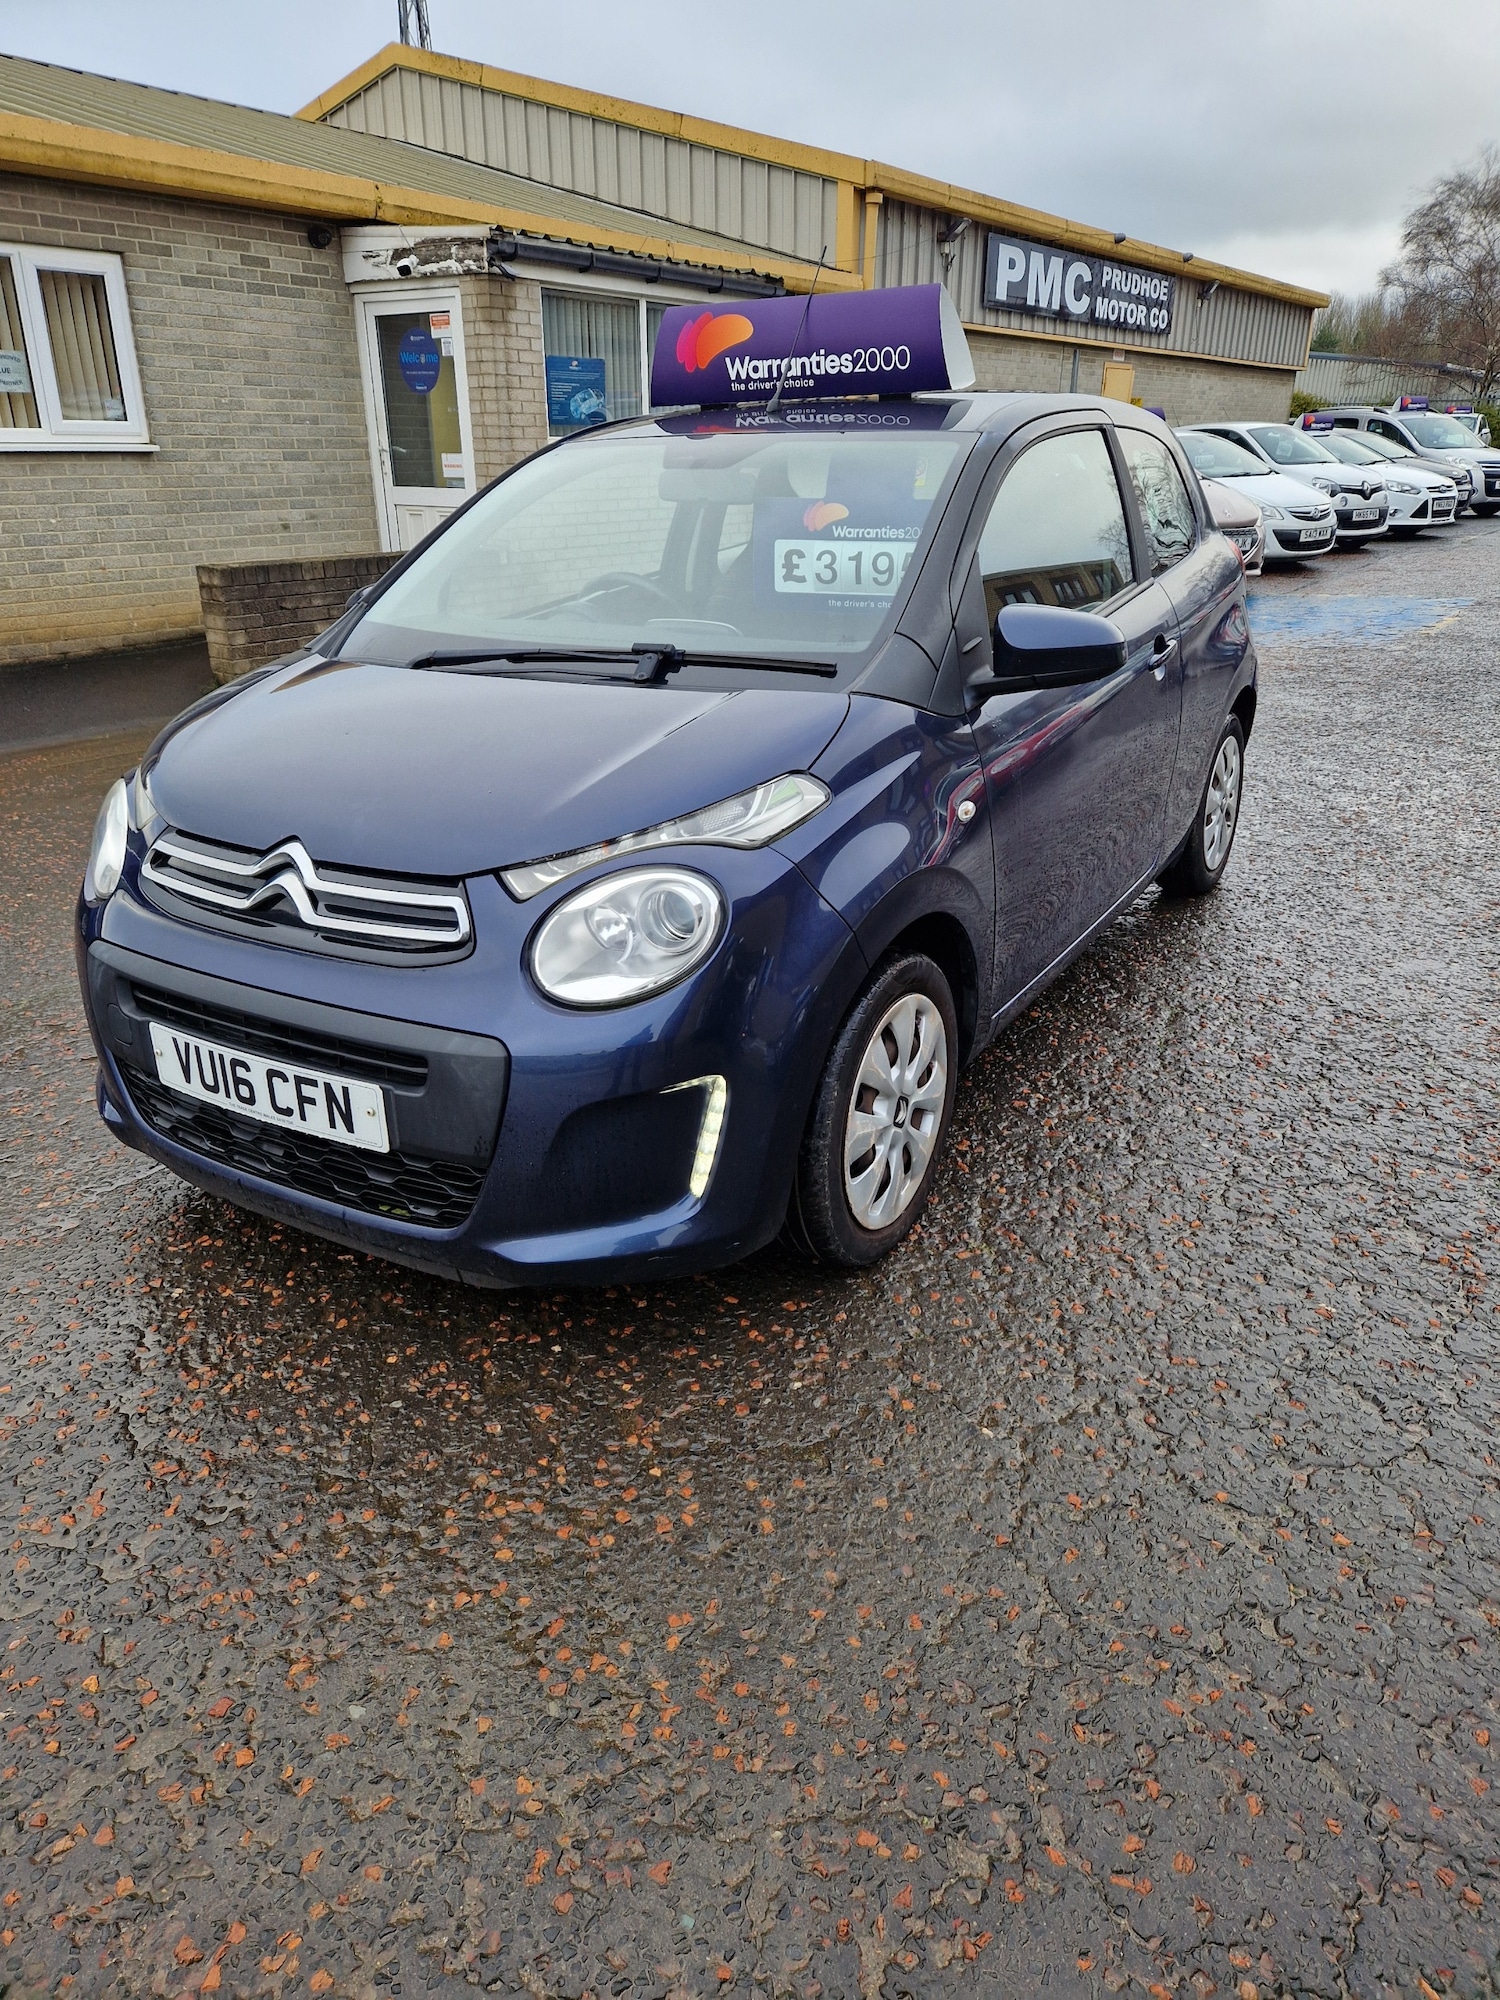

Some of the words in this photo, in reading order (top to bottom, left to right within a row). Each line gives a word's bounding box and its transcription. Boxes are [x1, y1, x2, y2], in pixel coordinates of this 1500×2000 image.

[995, 243, 1092, 314] PMC
[1101, 265, 1169, 301] PRUDHOE
[1095, 296, 1146, 326] MOTOR
[1149, 307, 1168, 330] CO
[725, 345, 911, 380] Warranties2000
[730, 382, 746, 392] the
[748, 379, 780, 391] driver's
[784, 378, 815, 389] choice
[832, 525, 922, 539] Warranties20
[828, 599, 842, 607] the
[844, 599, 874, 608] driver's
[171, 1036, 256, 1107] VU16
[265, 1068, 355, 1135] CFN
